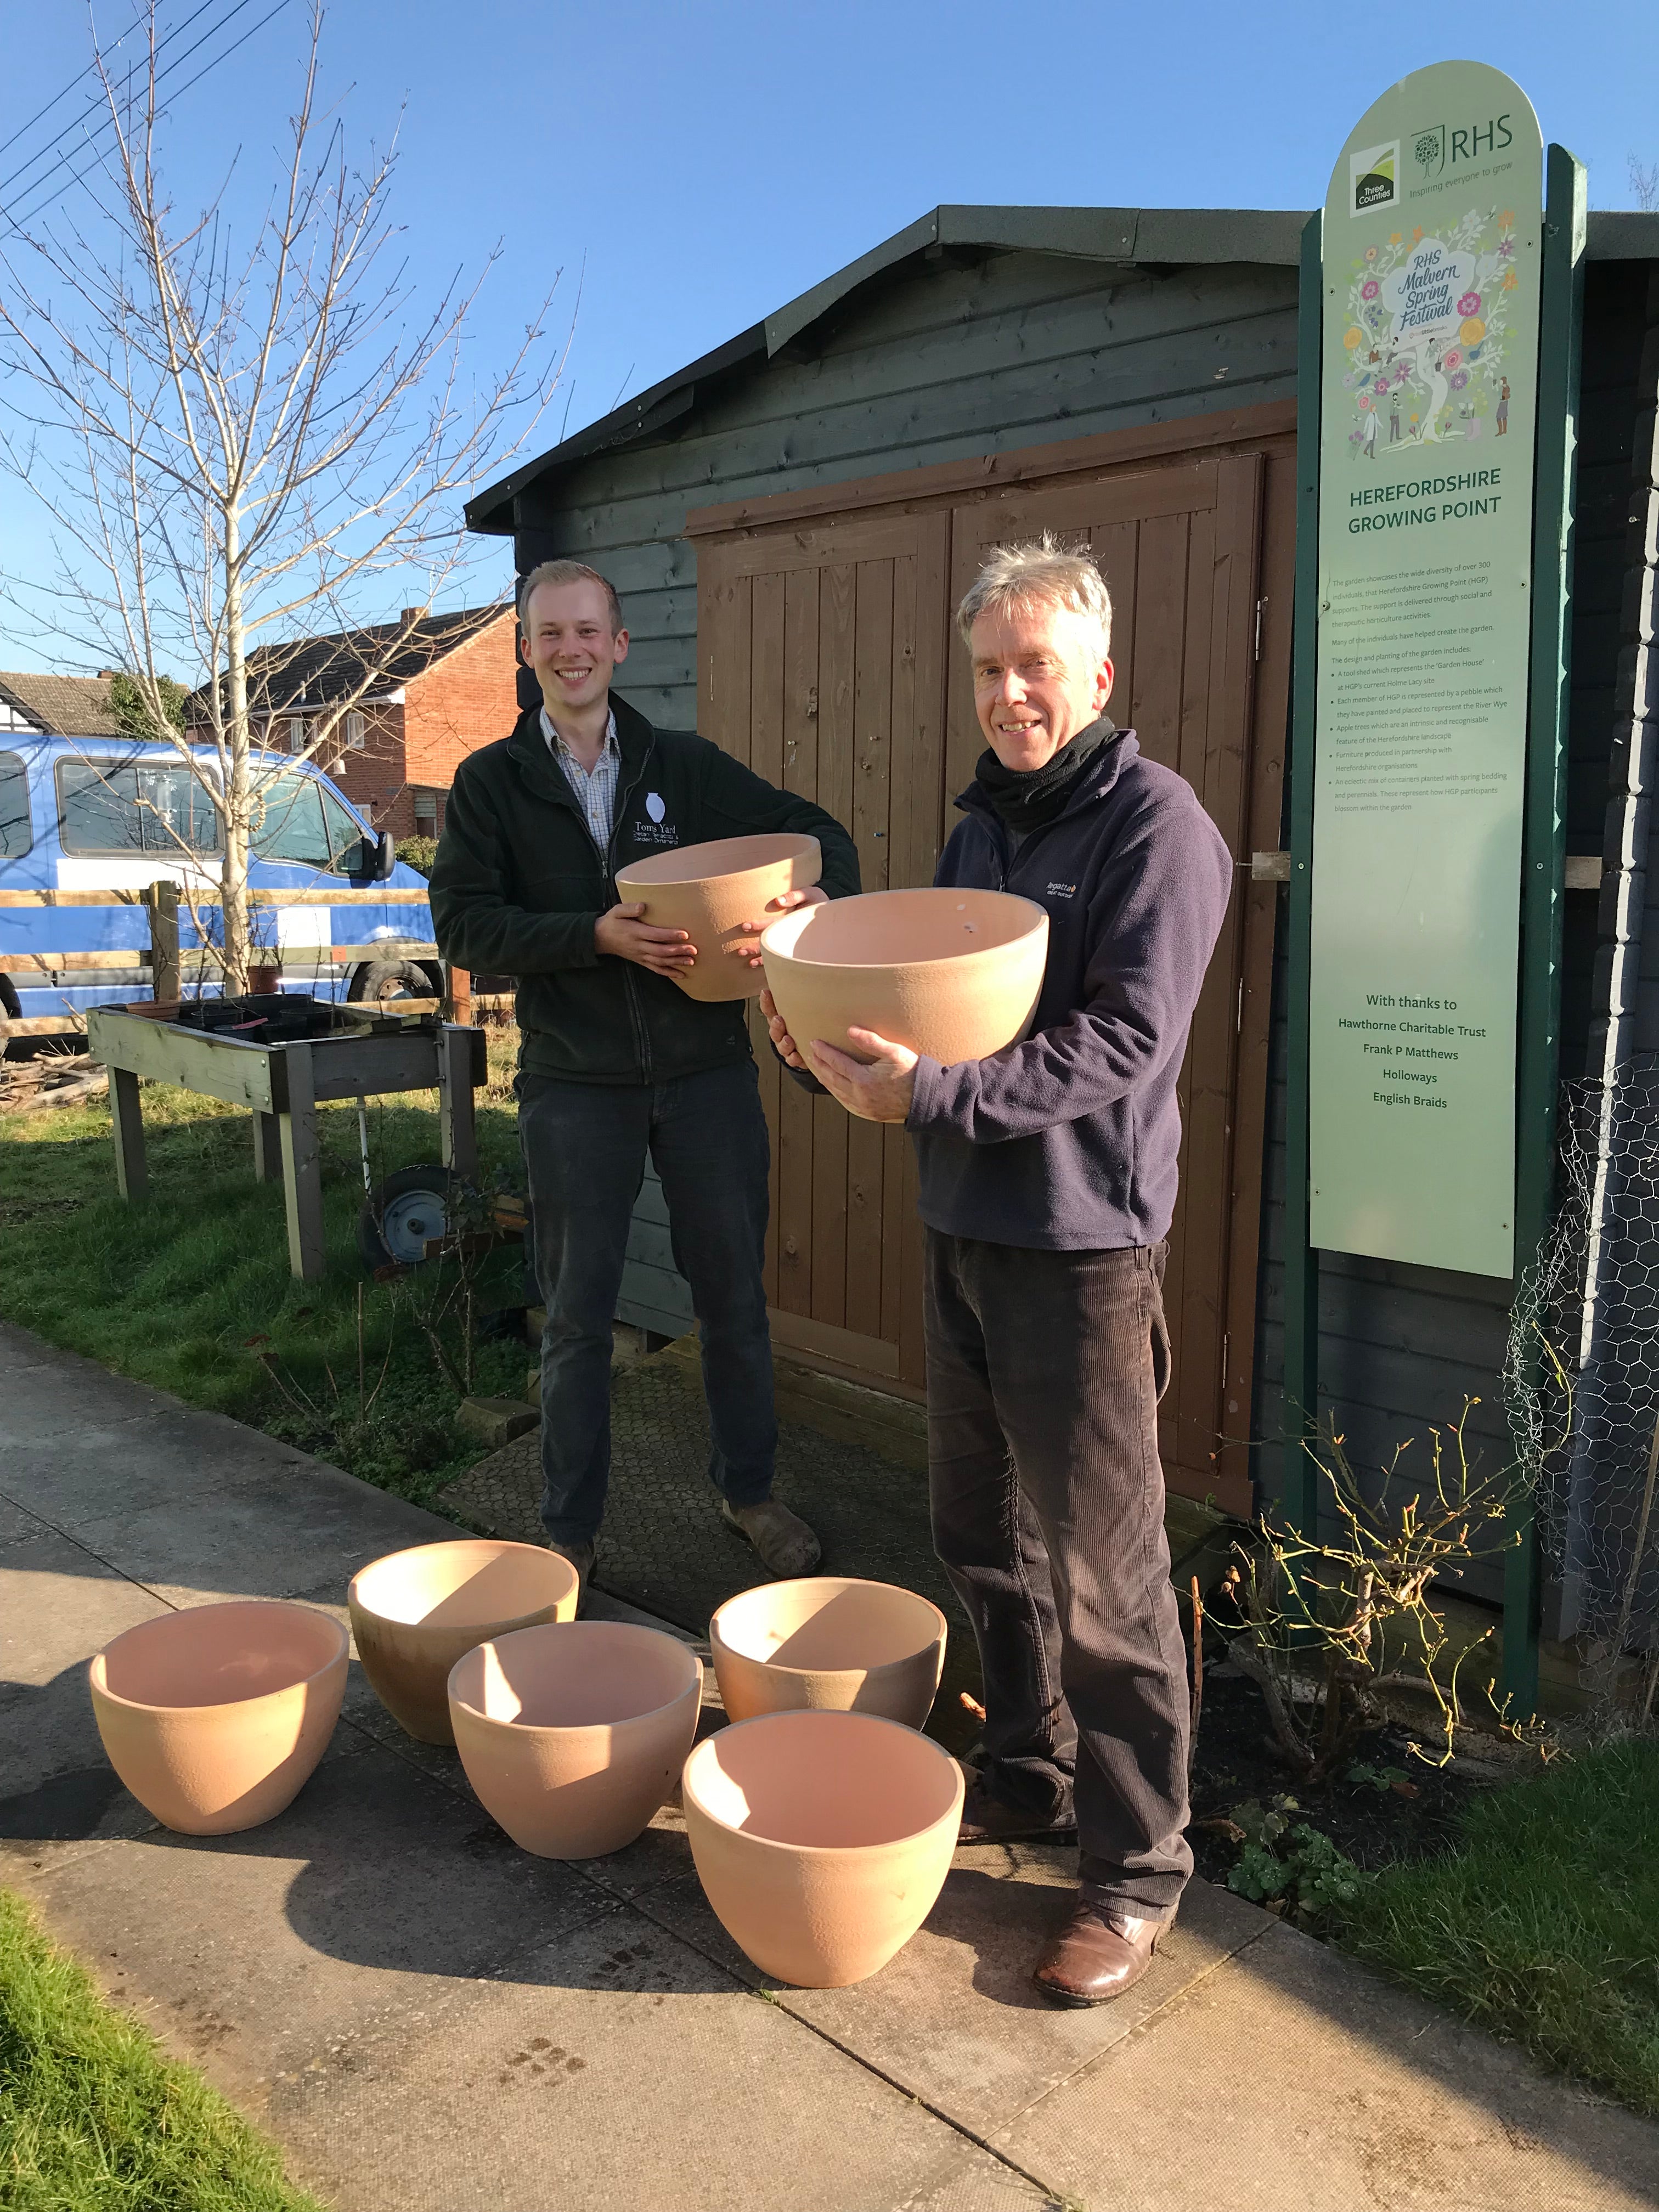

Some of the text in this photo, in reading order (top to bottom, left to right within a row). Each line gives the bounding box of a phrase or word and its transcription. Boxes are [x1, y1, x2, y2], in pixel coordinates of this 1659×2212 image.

[1452, 114, 1513, 163] RHS
[1409, 162, 1513, 198] Inspiring everyone to grow
[1359, 190, 1391, 205] Counties
[1365, 185, 1385, 196] Three
[1414, 250, 1442, 270] RHS
[1398, 266, 1460, 294] Malvern
[1406, 284, 1449, 309] Spring
[1400, 297, 1453, 331] Festival
[1350, 468, 1500, 507] HEREFORDSHIRE
[1348, 497, 1501, 534] GROWING POINT
[1345, 578, 1364, 586] garden
[1367, 574, 1397, 583] showcases
[1426, 567, 1452, 575] diversity
[1379, 585, 1420, 595] Herefordshire
[1468, 577, 1488, 586] (HGP)
[1373, 601, 1397, 610] support
[1404, 597, 1432, 606] delivered
[1434, 594, 1459, 602] through
[1460, 591, 1478, 600] social
[1332, 619, 1365, 628] therapeutic
[1367, 616, 1402, 624] horticulture
[1367, 634, 1398, 642] individuals
[1415, 630, 1436, 639] helped
[1376, 652, 1400, 661] planting
[1421, 648, 1442, 657] garden
[1391, 664, 1423, 674] represents
[1408, 690, 1444, 700] represented
[1461, 687, 1482, 697] pebble
[1366, 708, 1388, 717] painted
[1402, 706, 1421, 715] placed
[1432, 704, 1462, 713] represent
[1336, 724, 1353, 732] Apple
[1449, 716, 1488, 725] recognisable
[1378, 734, 1419, 742] Herefordshire
[1365, 749, 1393, 758] produced
[1402, 747, 1437, 757] partnership
[1378, 763, 1418, 771] organisations
[1421, 775, 1443, 783] planted
[1400, 789, 1429, 798] represent
[1460, 787, 1498, 796] participants
[1391, 803, 1412, 812] garden
[635, 821, 675, 834] Toms Yard
[1367, 994, 1457, 1010] With thanks to
[1339, 1018, 1486, 1037] Hawthorne Charitable Trust
[1363, 1044, 1458, 1060] Frank P Matthews
[1383, 1069, 1437, 1085] Holloways
[1373, 1092, 1447, 1108] English Braids
